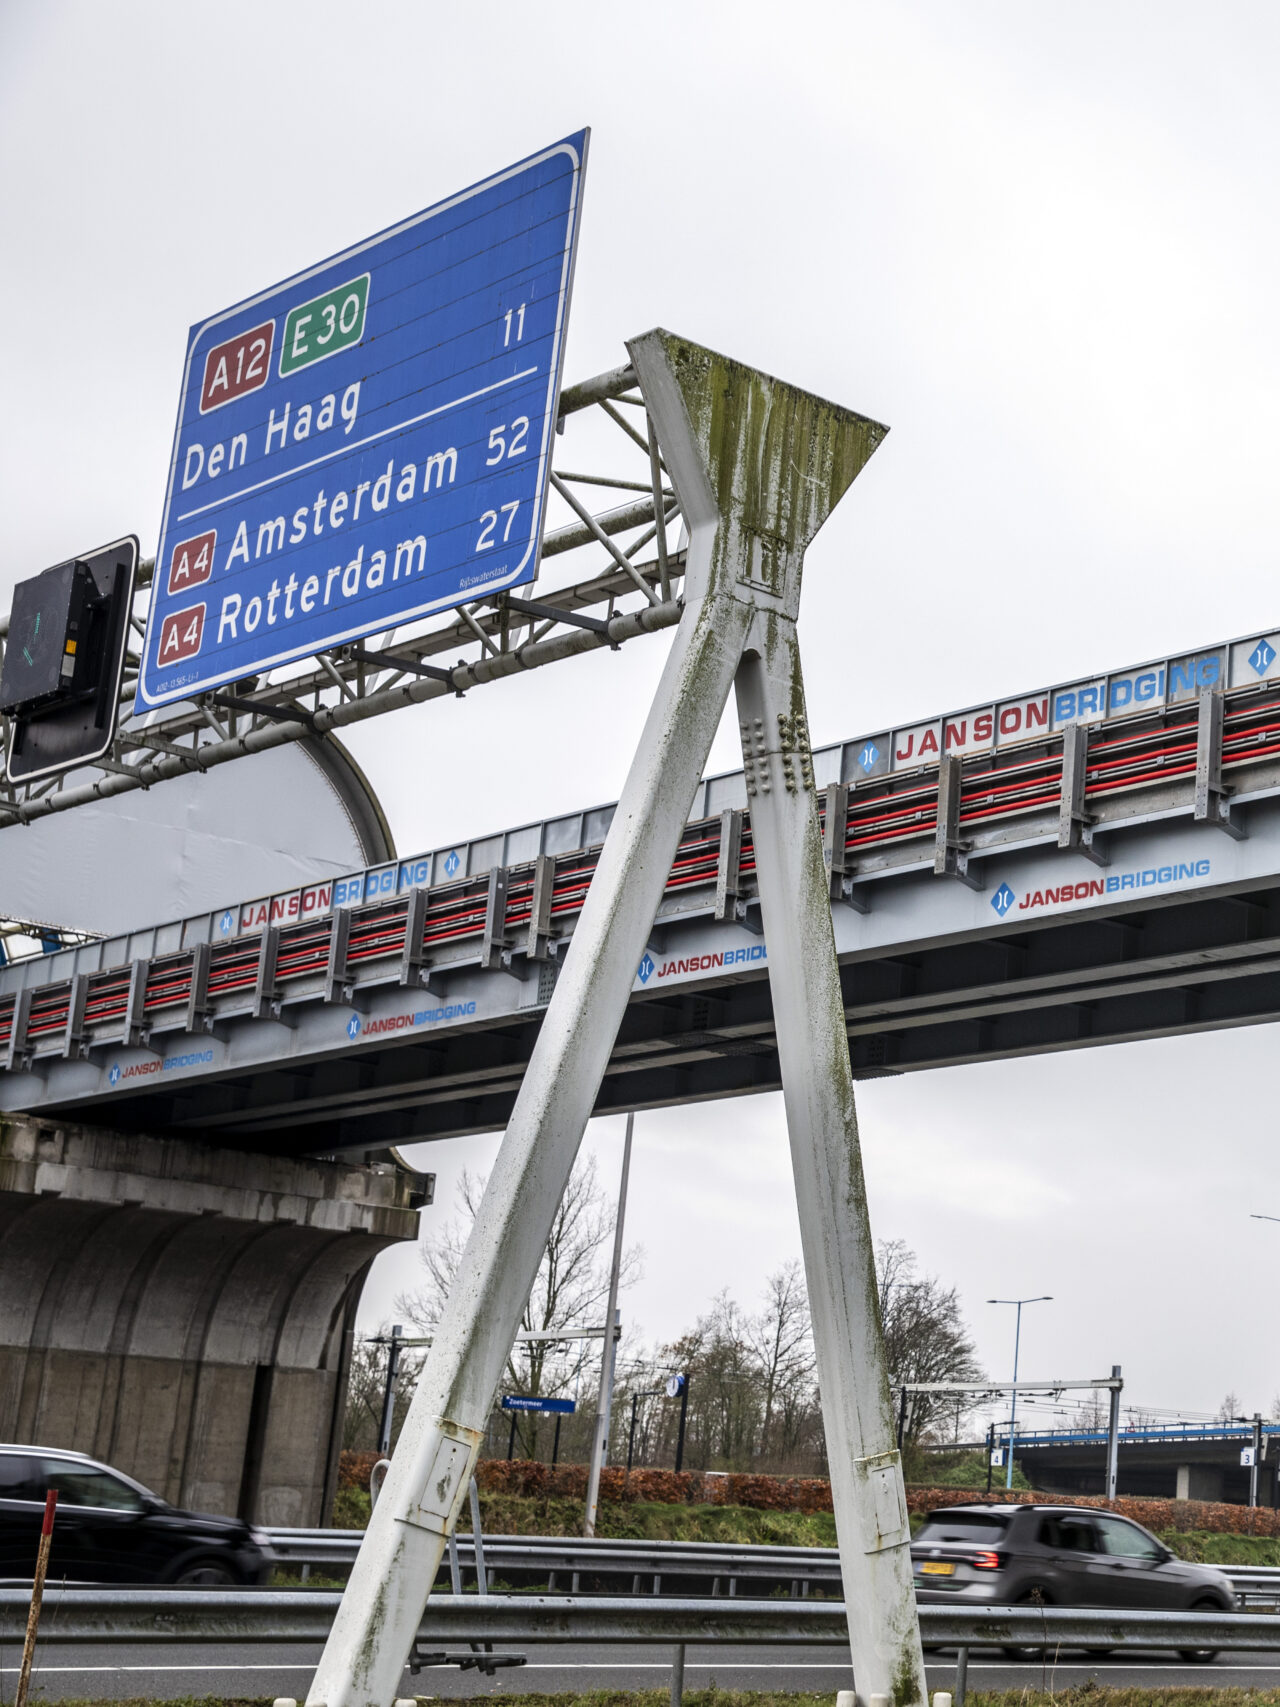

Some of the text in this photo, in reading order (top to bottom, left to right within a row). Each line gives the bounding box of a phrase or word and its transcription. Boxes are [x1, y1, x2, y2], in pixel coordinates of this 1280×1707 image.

[208, 338, 266, 398] A12
[182, 303, 526, 491] Den Haag 11
[225, 415, 529, 571] Amsterdam 52
[174, 542, 209, 583] A4
[217, 500, 520, 643] Rotterdam 27
[163, 616, 198, 656] A4
[509, 1398, 543, 1408] Zoetermeer
[1244, 1454, 1250, 1464] 3
